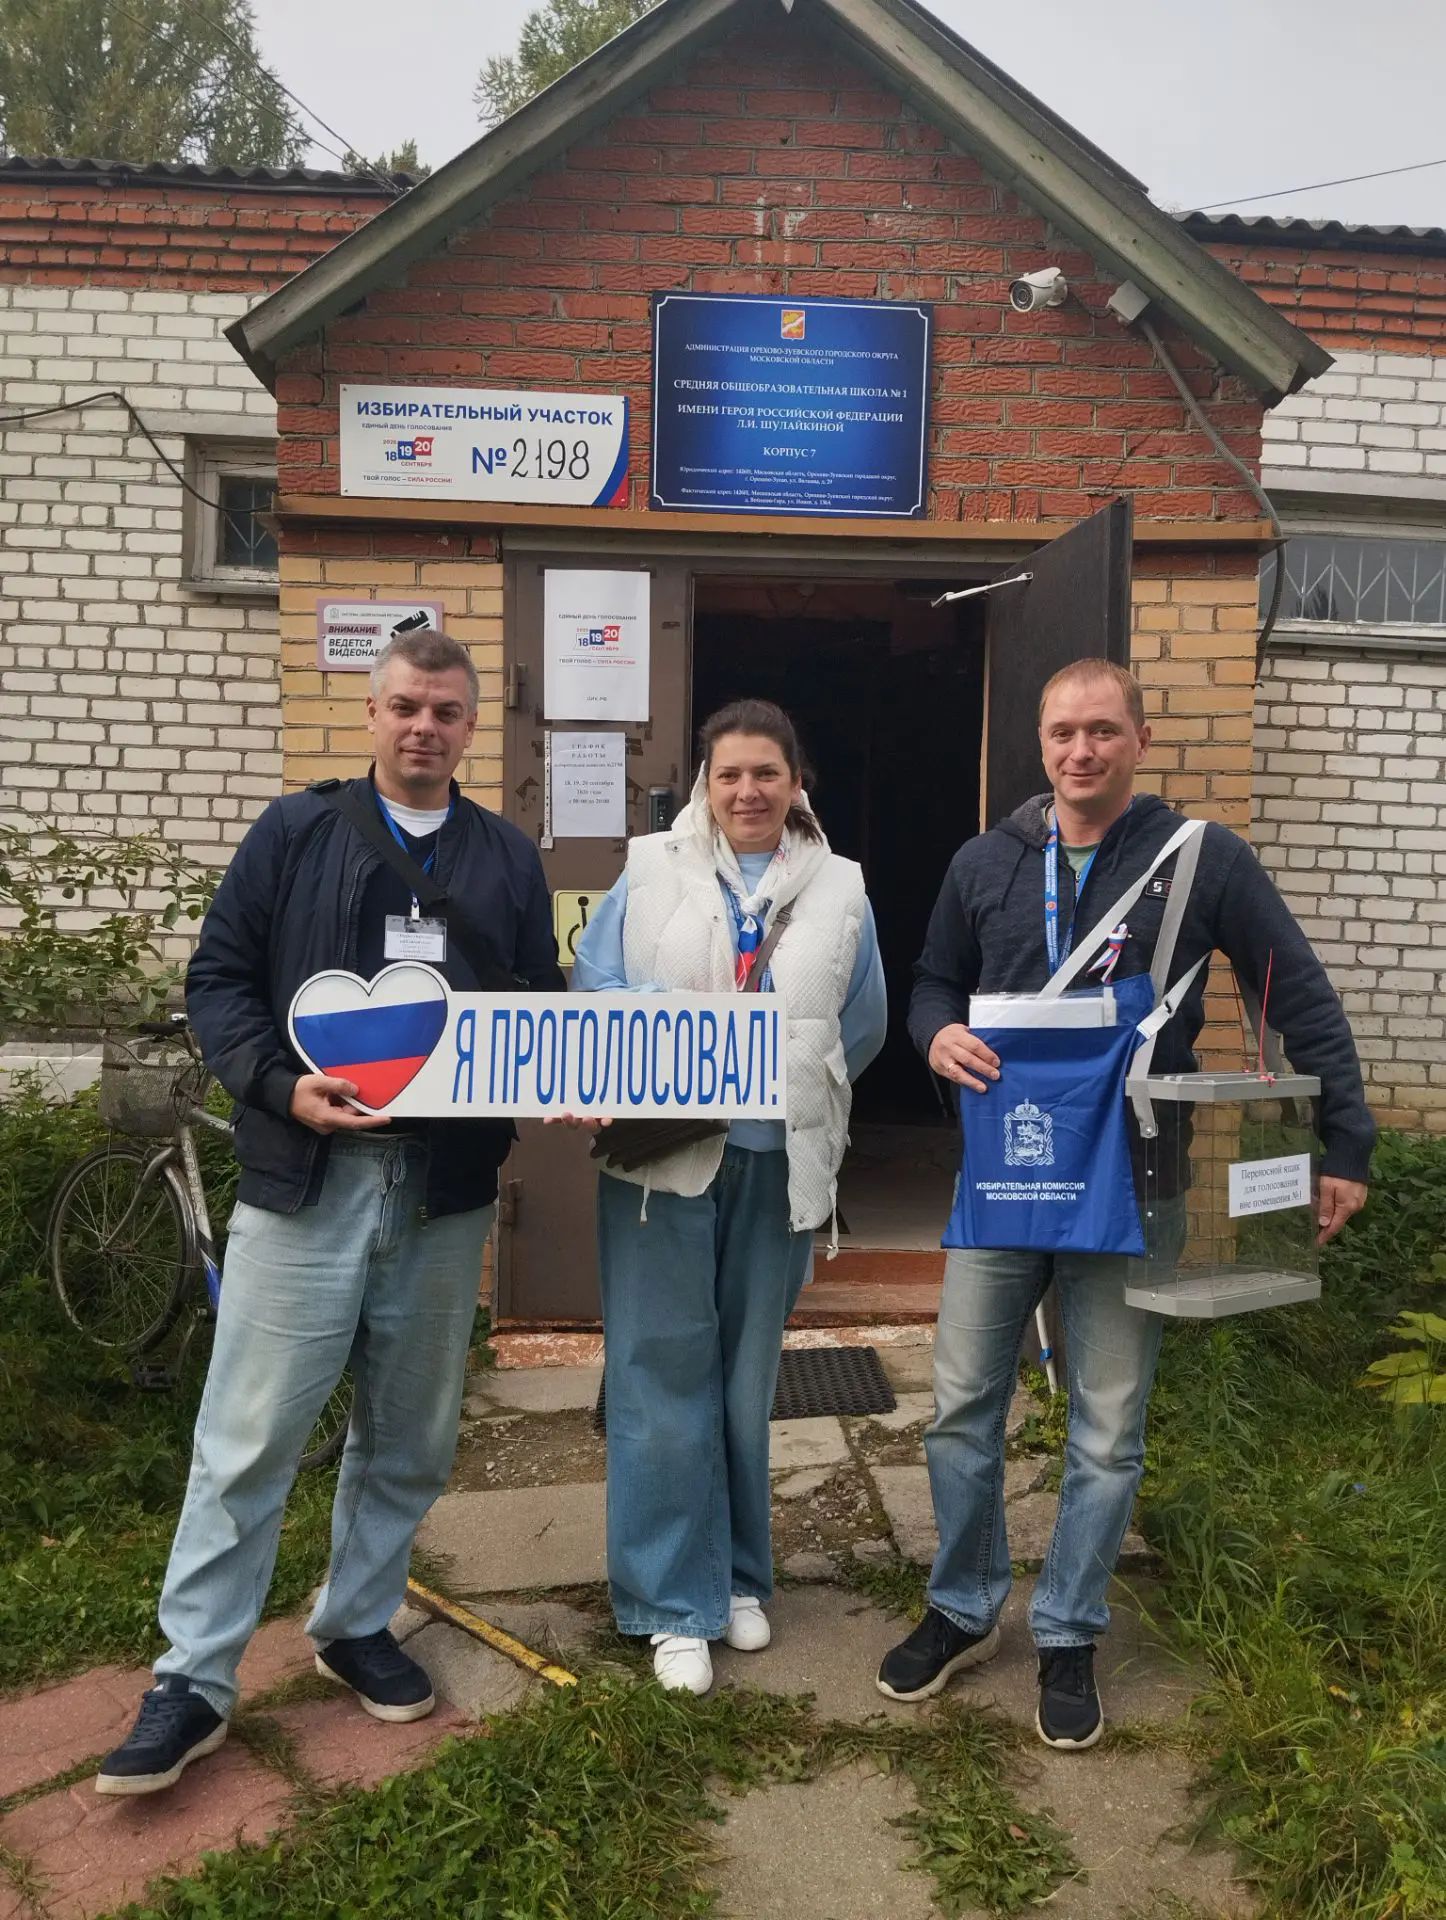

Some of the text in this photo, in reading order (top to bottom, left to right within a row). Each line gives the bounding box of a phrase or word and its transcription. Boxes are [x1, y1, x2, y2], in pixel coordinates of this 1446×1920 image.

[685, 343, 898, 360] АДМИНИСТРАЦИЯ ОРЕХОВО-ЗУЕВСКОГО ГОРОДСКОГО ОКРУГА
[750, 355, 834, 365] МОСКОВСКОЙ ОБЛАСТИ
[673, 379, 719, 390] СРЕДНЯЯ
[721, 381, 848, 396] ОБЩЕОБРАЗОВАТЕЛЬНАЯ
[850, 387, 888, 398] ШКОЛА
[357, 401, 613, 426] ИЗБИРАТЕЛЬНЫЙ УЧАСТОК
[678, 404, 903, 423] ИМЕНИ ГЕРОЯ РОССИЙСКОЙ ФЕДЕРАЦИИ
[736, 420, 844, 432] Л.И. ШУЛАЙКИНОЙ
[385, 441, 430, 461] 18 19 20
[763, 446, 816, 459] КОРПУС 7
[328, 625, 377, 634] ВНИМАНИЕ
[328, 638, 372, 648] ВЕДЕТСЯ
[577, 629, 617, 647] 18 19 20
[452, 1009, 778, 1106] Я ПРОГОЛОСОВАЛ!
[1241, 1164, 1300, 1180] Переносной ящик
[976, 1182, 1085, 1190] ИЗБИРАТЕЛЬНАЯ КОМИССИЯ
[1243, 1179, 1298, 1195] для голосования
[986, 1191, 1076, 1200] МОСКОВСКОЙ ОБЛАСТИ
[1240, 1202, 1251, 1210] вне
[1252, 1194, 1291, 1208] помещения
